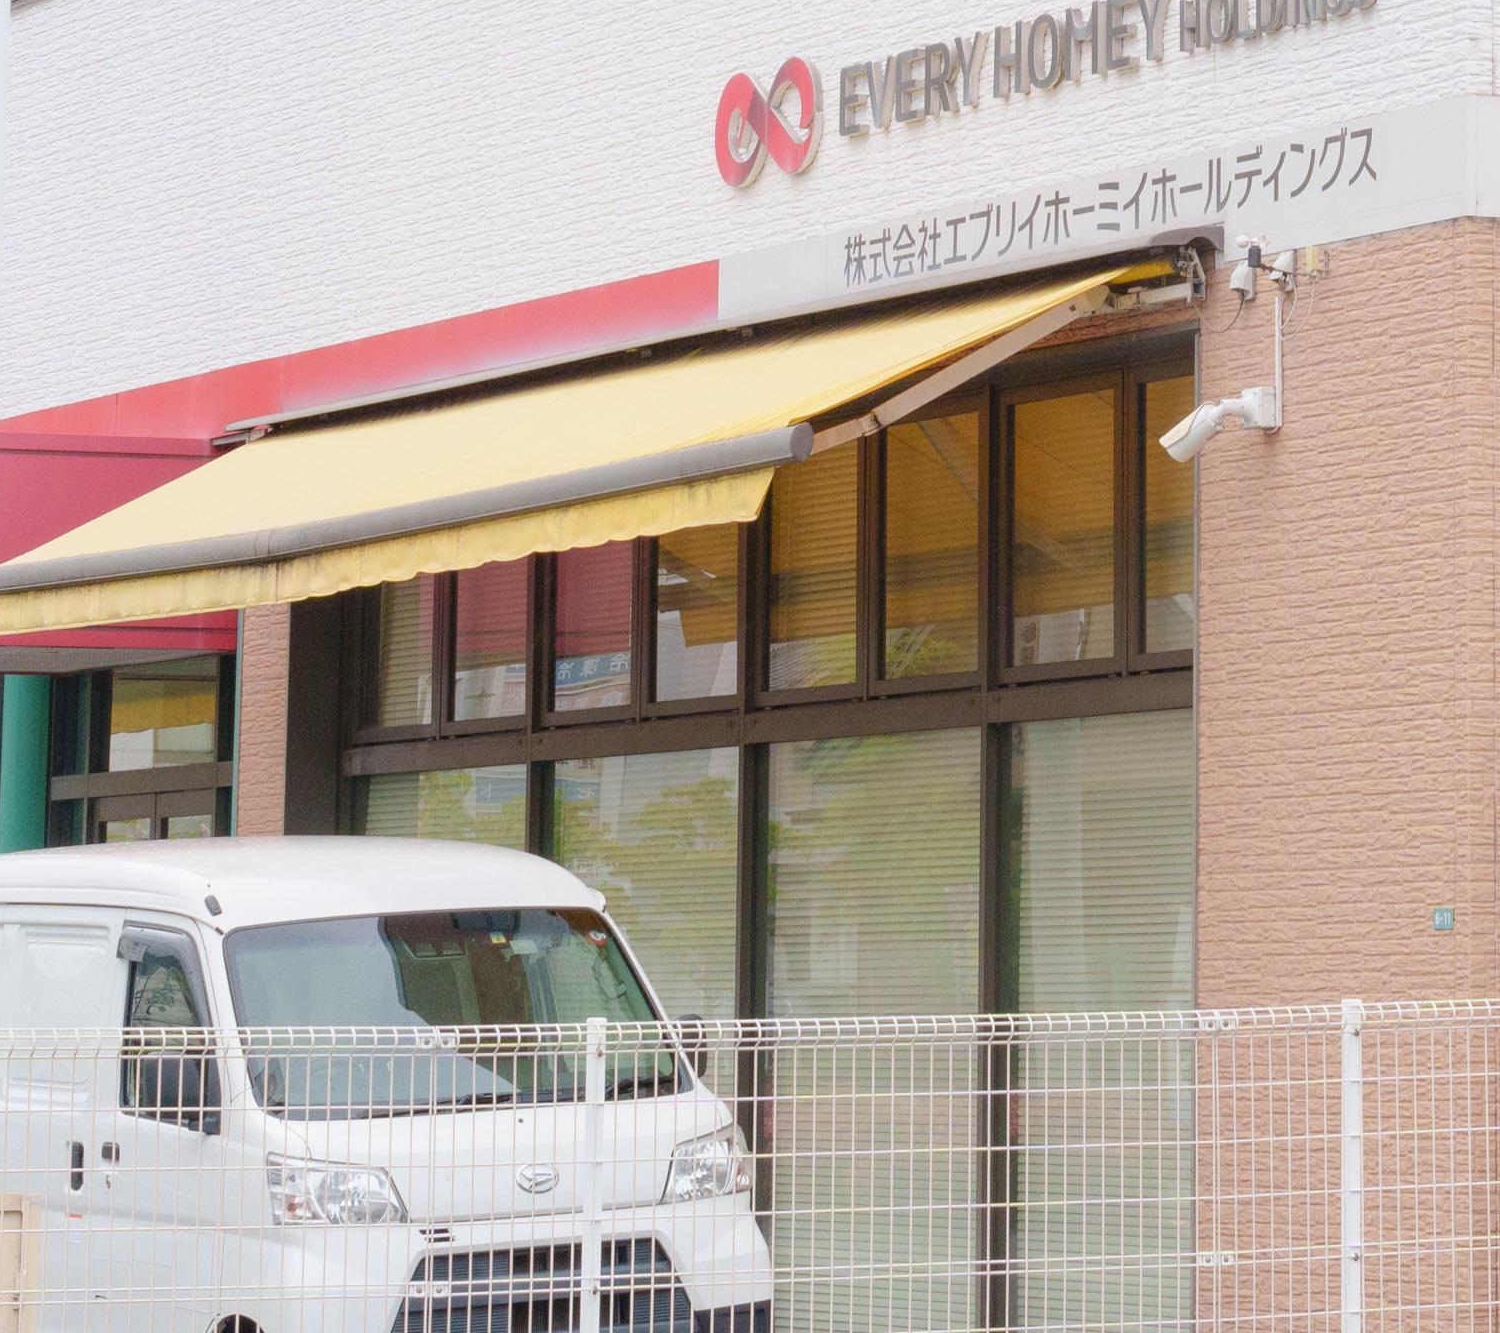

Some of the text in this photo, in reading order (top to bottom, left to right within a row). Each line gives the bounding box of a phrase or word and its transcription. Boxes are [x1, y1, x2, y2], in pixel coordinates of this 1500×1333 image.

[838, 30, 988, 137] EVERY
[843, 126, 1378, 289] 株式会社エブリイホーミイホールディングス
